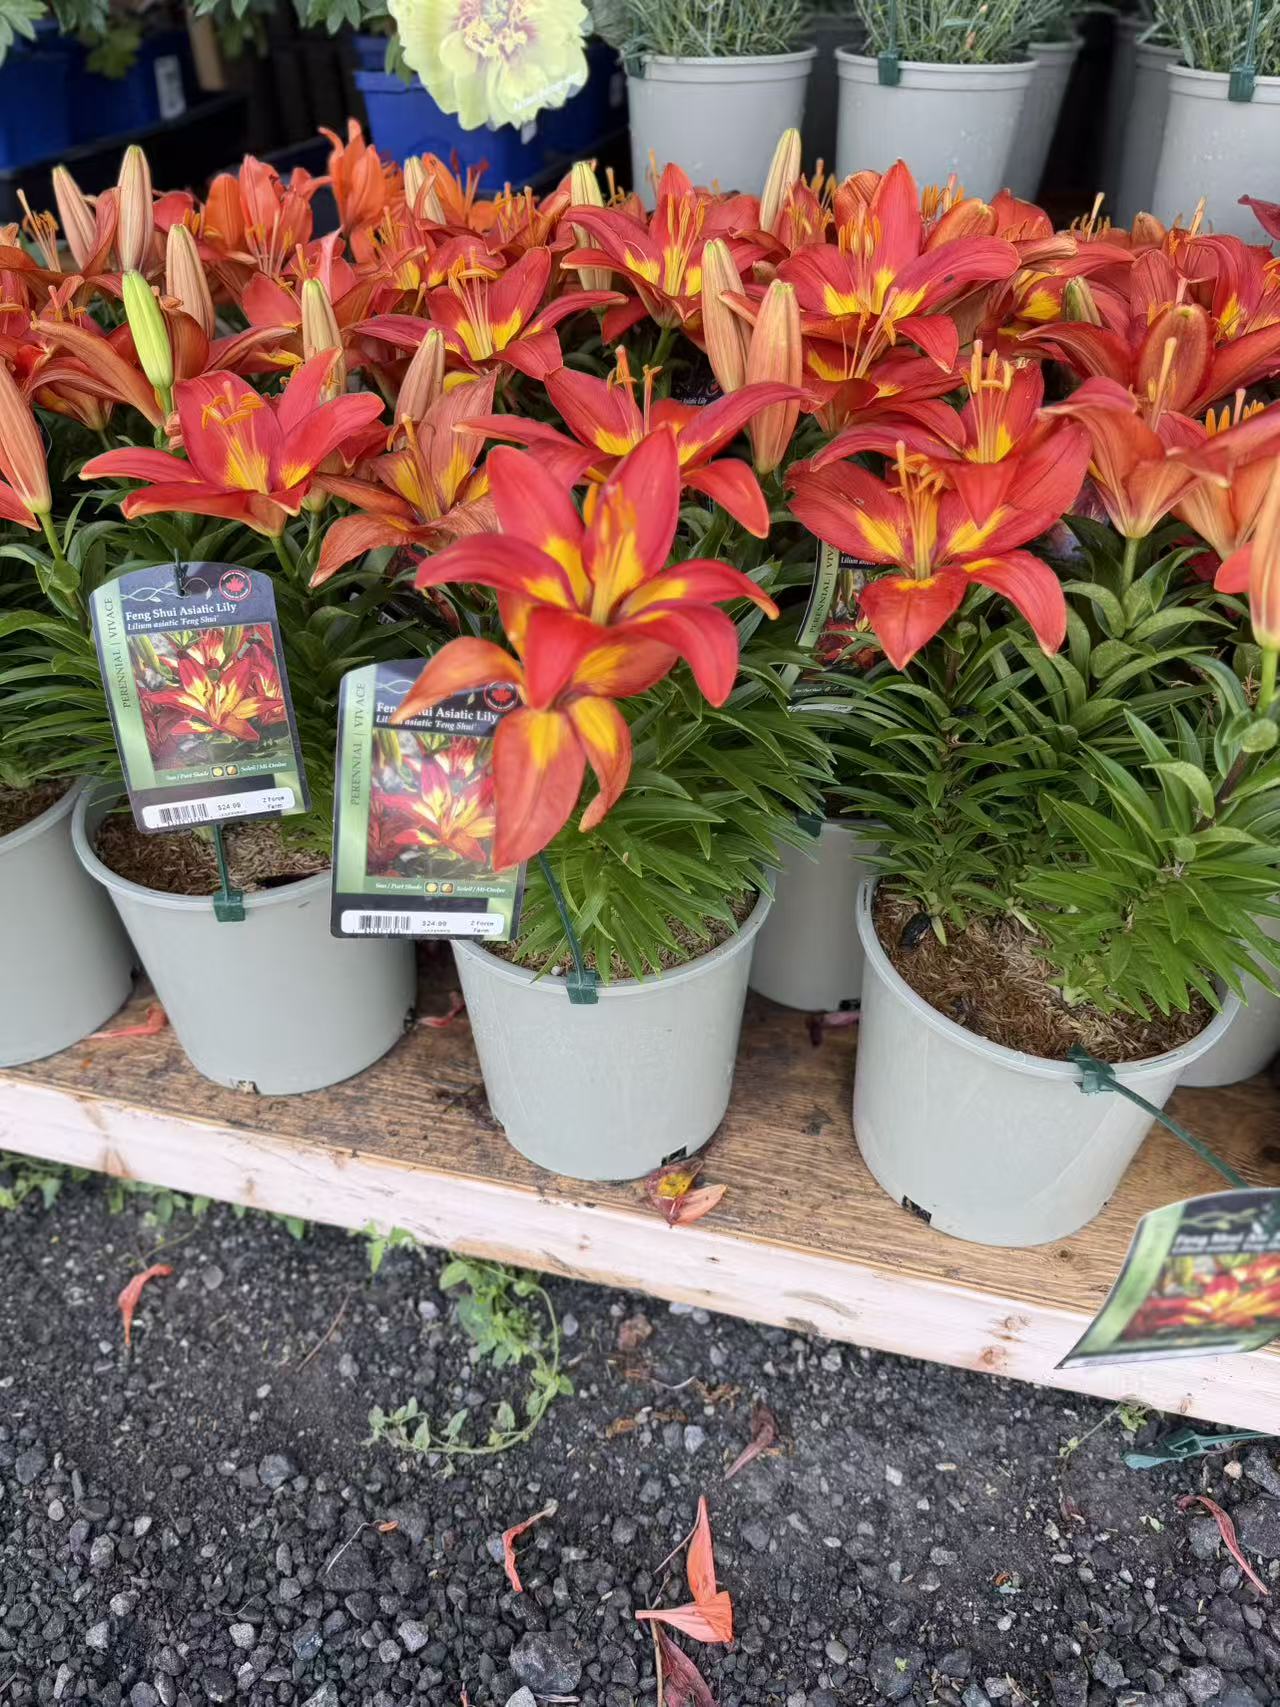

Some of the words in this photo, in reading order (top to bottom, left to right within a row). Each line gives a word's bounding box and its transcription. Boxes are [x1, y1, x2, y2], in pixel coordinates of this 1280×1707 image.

[104, 597, 118, 639] VIVACE
[125, 611, 151, 622] Feng
[152, 607, 177, 620] Shui
[180, 604, 214, 616] Asiatic
[215, 602, 237, 614] Lily
[127, 621, 152, 631] Lilium
[153, 619, 179, 628] asiatic
[112, 650, 131, 709] PERENNIAL
[354, 683, 366, 728] VIVACE
[376, 702, 397, 713] Fen
[436, 706, 474, 721] Asiatic
[476, 711, 499, 724] Lily
[404, 718, 433, 728] asiatic
[350, 743, 362, 806] PERENNIAL
